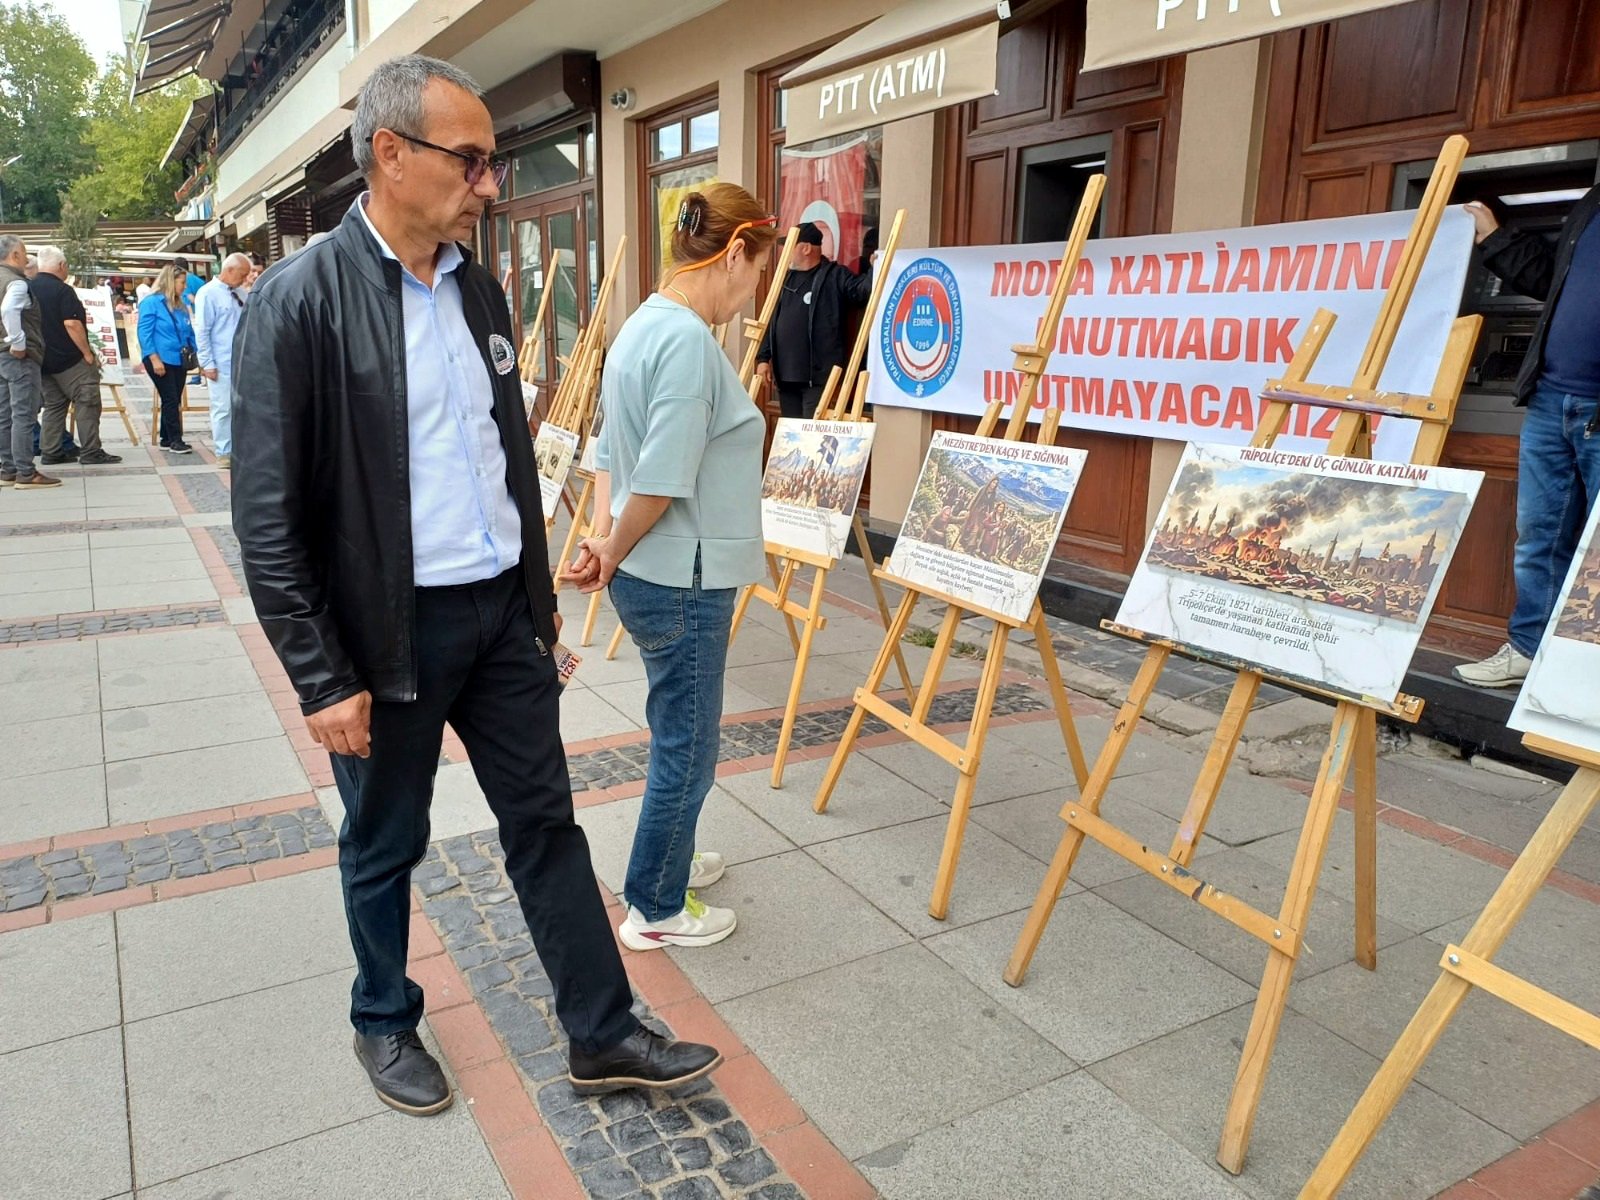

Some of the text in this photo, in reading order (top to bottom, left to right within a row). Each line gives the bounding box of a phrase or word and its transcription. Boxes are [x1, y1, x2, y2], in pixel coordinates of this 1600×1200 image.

[819, 47, 946, 120] PTT (ATM)
[918, 261, 945, 273] KÜLTÜR
[943, 270, 952, 285] VE
[996, 446, 1019, 459] KAÇIŞ
[1020, 449, 1033, 460] VE
[1032, 449, 1069, 466] SIĞINMA
[1239, 448, 1429, 481] TRİPOLİÇE'DEKİ ÜÇ GÜNLÜK KATLİAM
[1205, 593, 1227, 606] Ekim
[1229, 599, 1250, 611] 1821
[1252, 605, 1290, 621] tarihleri
[1291, 615, 1333, 632] arasında
[1265, 618, 1311, 638] katliamda
[1190, 613, 1311, 652] tamamen harabeye çevrildi.
